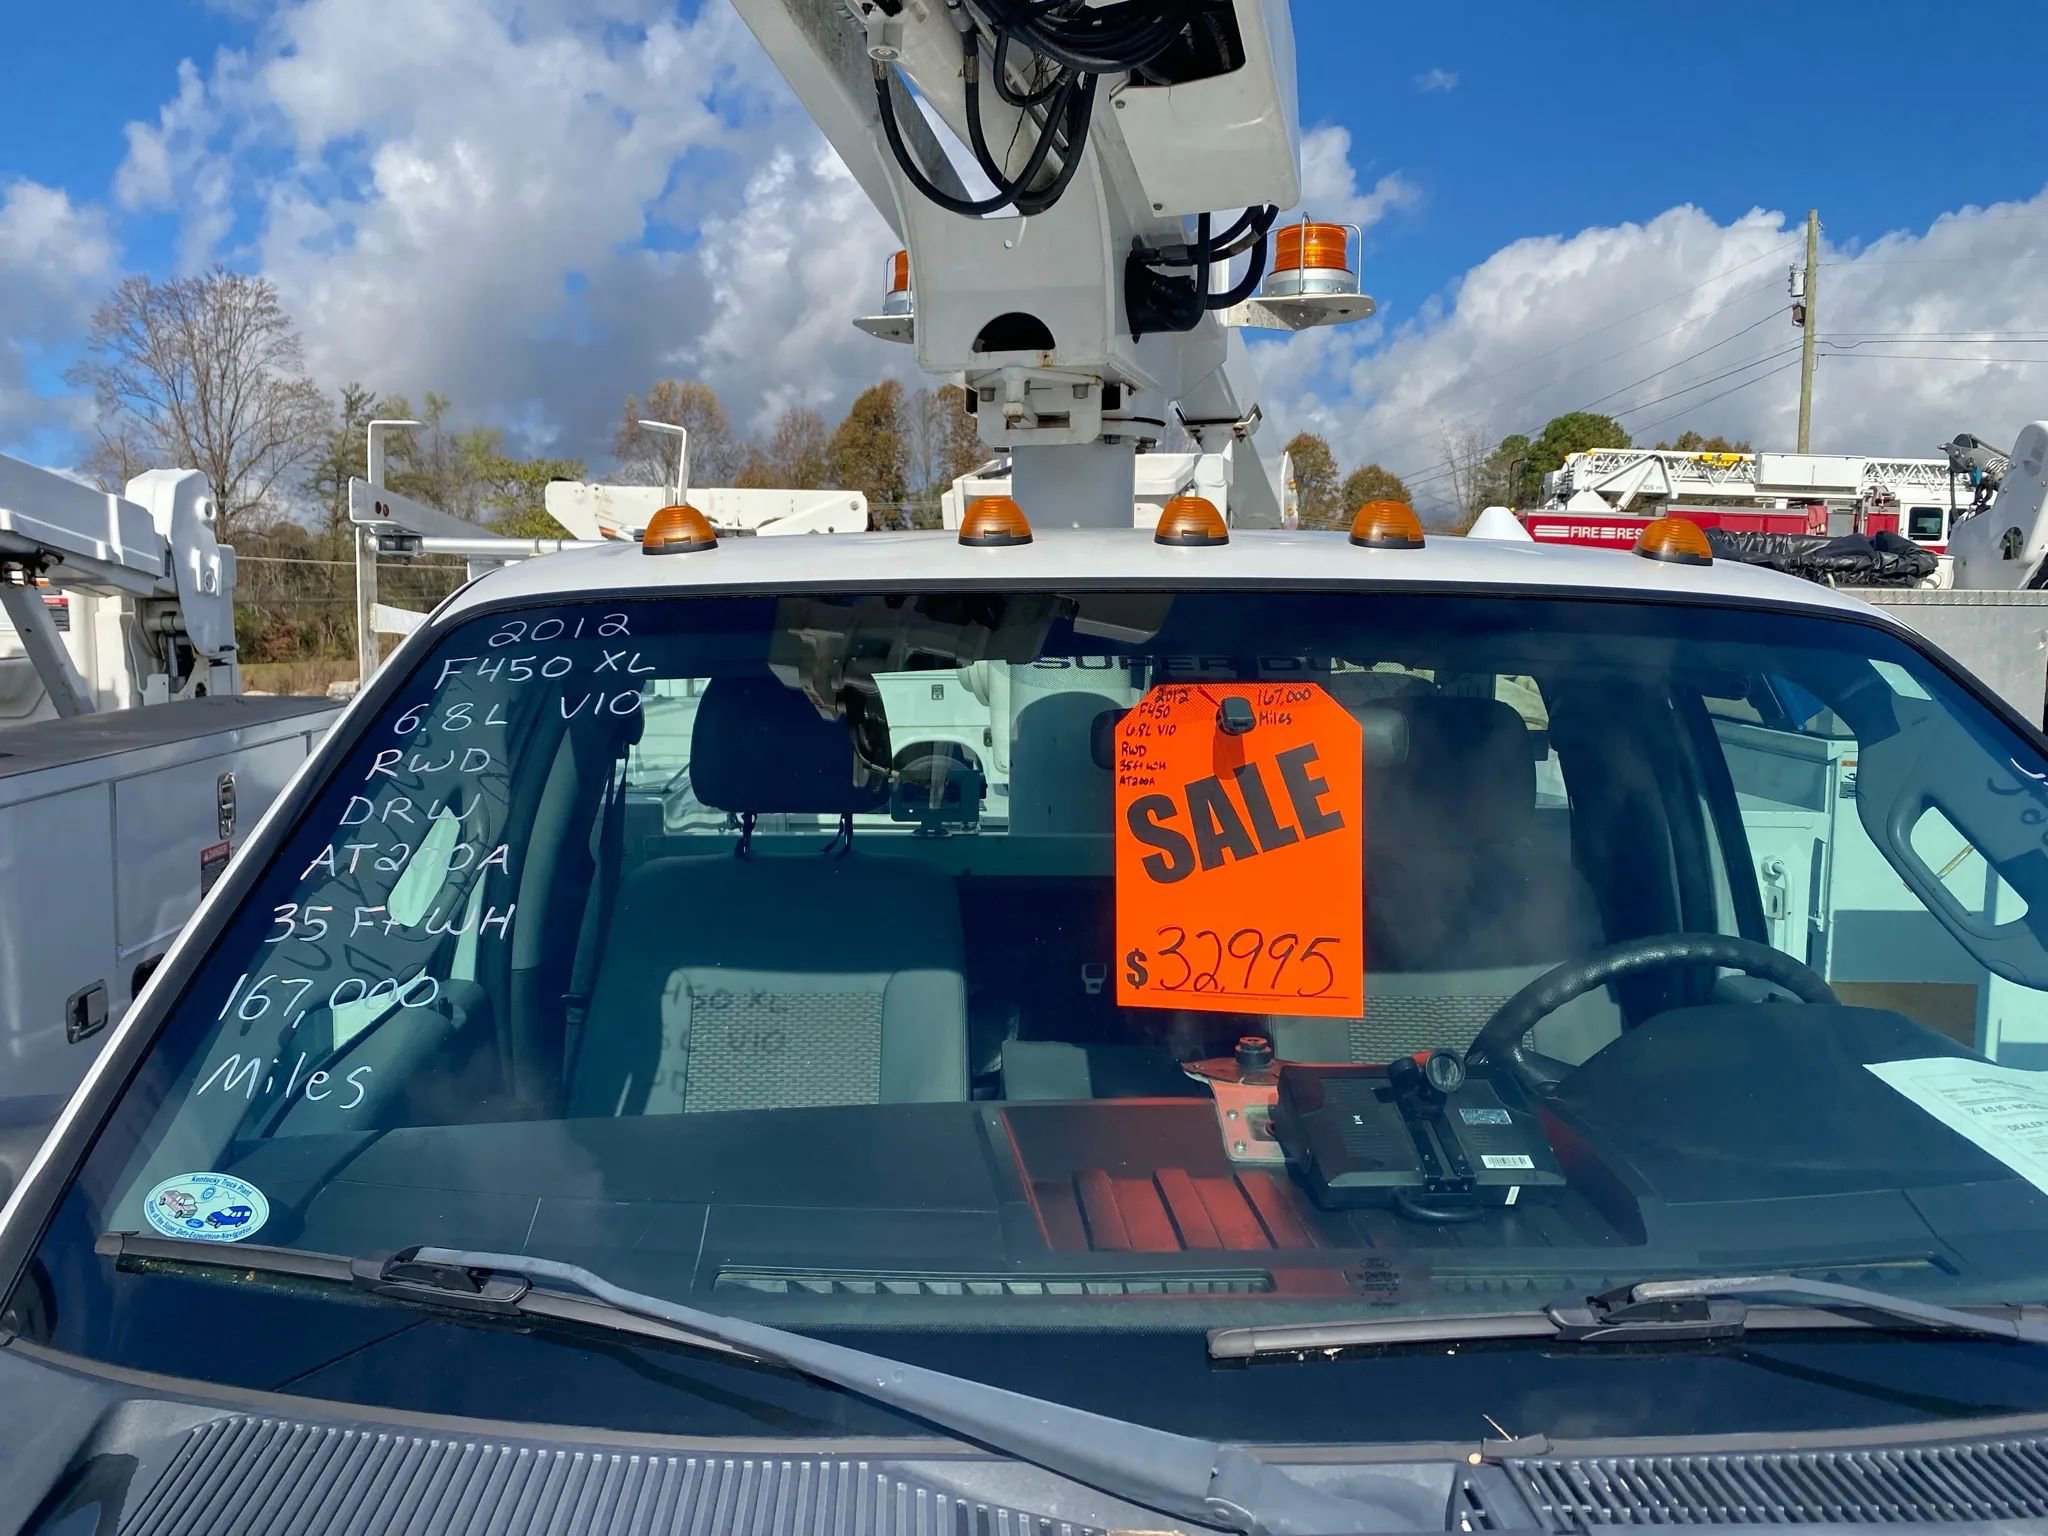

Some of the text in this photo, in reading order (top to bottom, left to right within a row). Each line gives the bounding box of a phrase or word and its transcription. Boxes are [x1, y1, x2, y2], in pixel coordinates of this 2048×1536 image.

[1570, 526, 1600, 538] FIRE
[488, 613, 631, 647] 2012
[434, 650, 655, 690] F450 XL
[560, 690, 642, 720] V10
[1155, 687, 1312, 706] 2012 167,000
[1139, 702, 1293, 726] F450 Miles
[365, 749, 490, 781] RWD
[1122, 741, 1147, 757] RWD
[338, 795, 473, 826] DRW
[1126, 742, 1346, 884] SALE
[301, 843, 510, 881] AT200A
[264, 905, 331, 943] 35
[423, 903, 517, 938] WH
[218, 973, 440, 1028] 167,000
[197, 1053, 371, 1109] Miles
[191, 1176, 252, 1197] Kentucky Truck Plant
